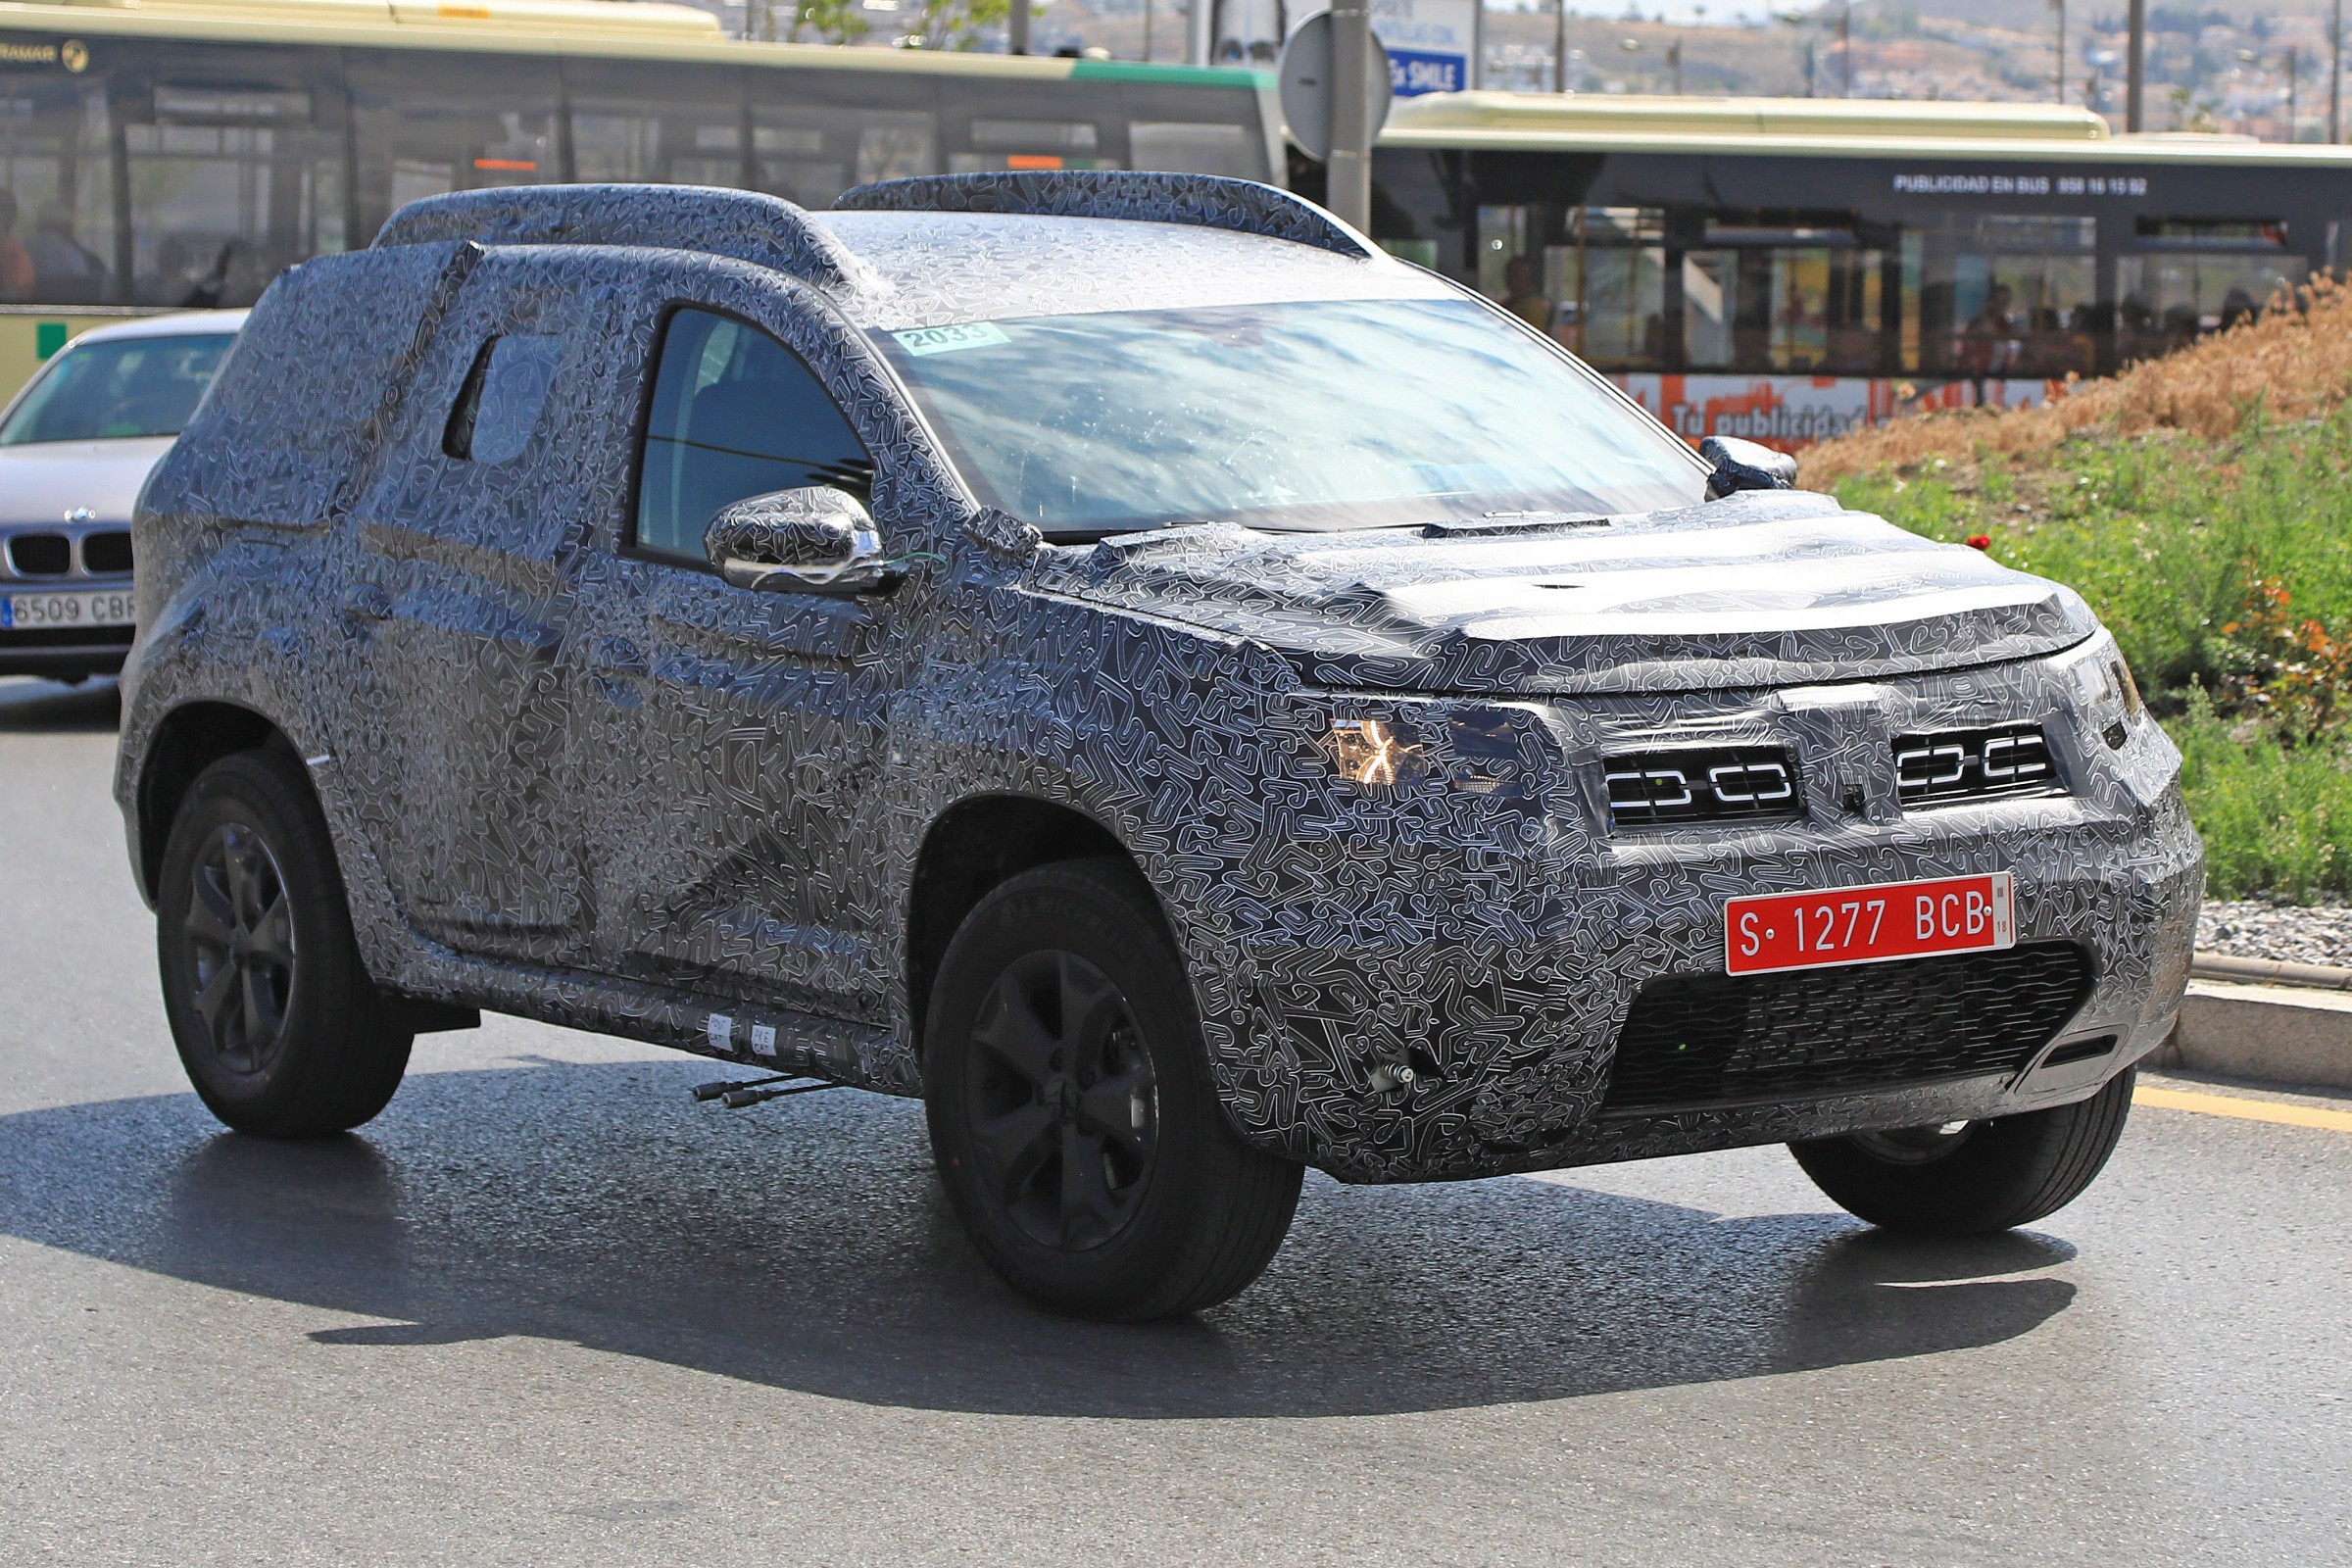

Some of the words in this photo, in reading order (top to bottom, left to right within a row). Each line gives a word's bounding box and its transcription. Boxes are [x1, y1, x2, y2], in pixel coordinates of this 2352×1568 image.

[1893, 174, 1989, 193] PUBLICIDAD
[1990, 175, 2014, 194] EN
[2015, 175, 2050, 195] BUS
[904, 322, 988, 347] 2033
[14, 596, 79, 623] 6509
[1740, 912, 1760, 956] S
[1793, 900, 1886, 952] 1277
[1915, 891, 1984, 940] BCB
